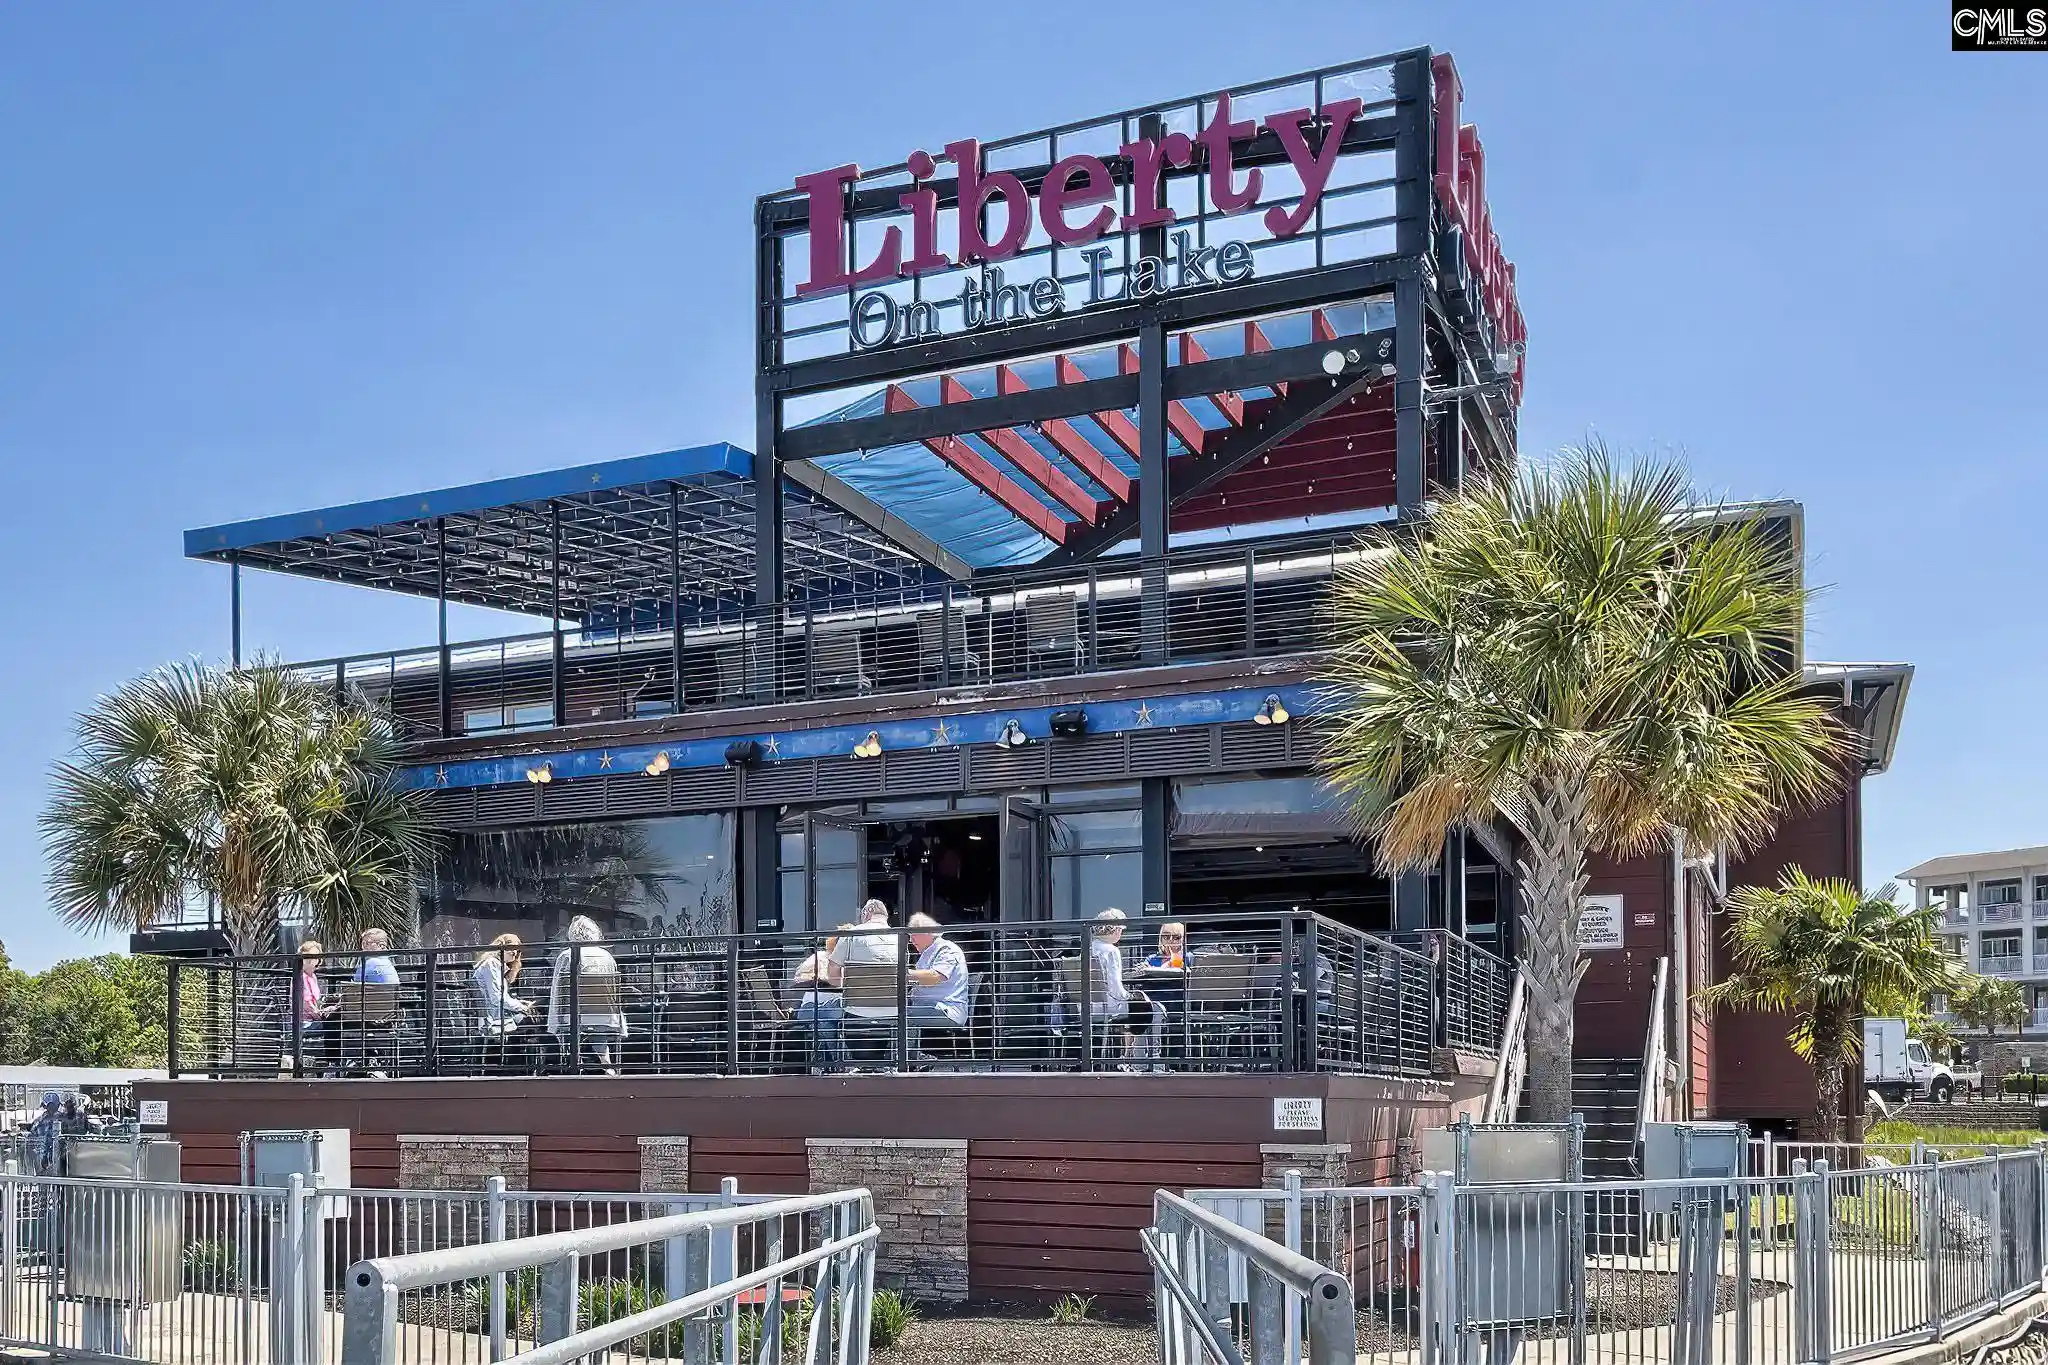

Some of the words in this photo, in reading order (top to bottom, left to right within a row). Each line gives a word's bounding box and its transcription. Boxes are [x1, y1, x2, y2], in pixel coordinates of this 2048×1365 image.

[795, 91, 1363, 297] Liberty
[850, 291, 943, 349] On
[957, 265, 1065, 330] the
[1080, 229, 1255, 308] Lake
